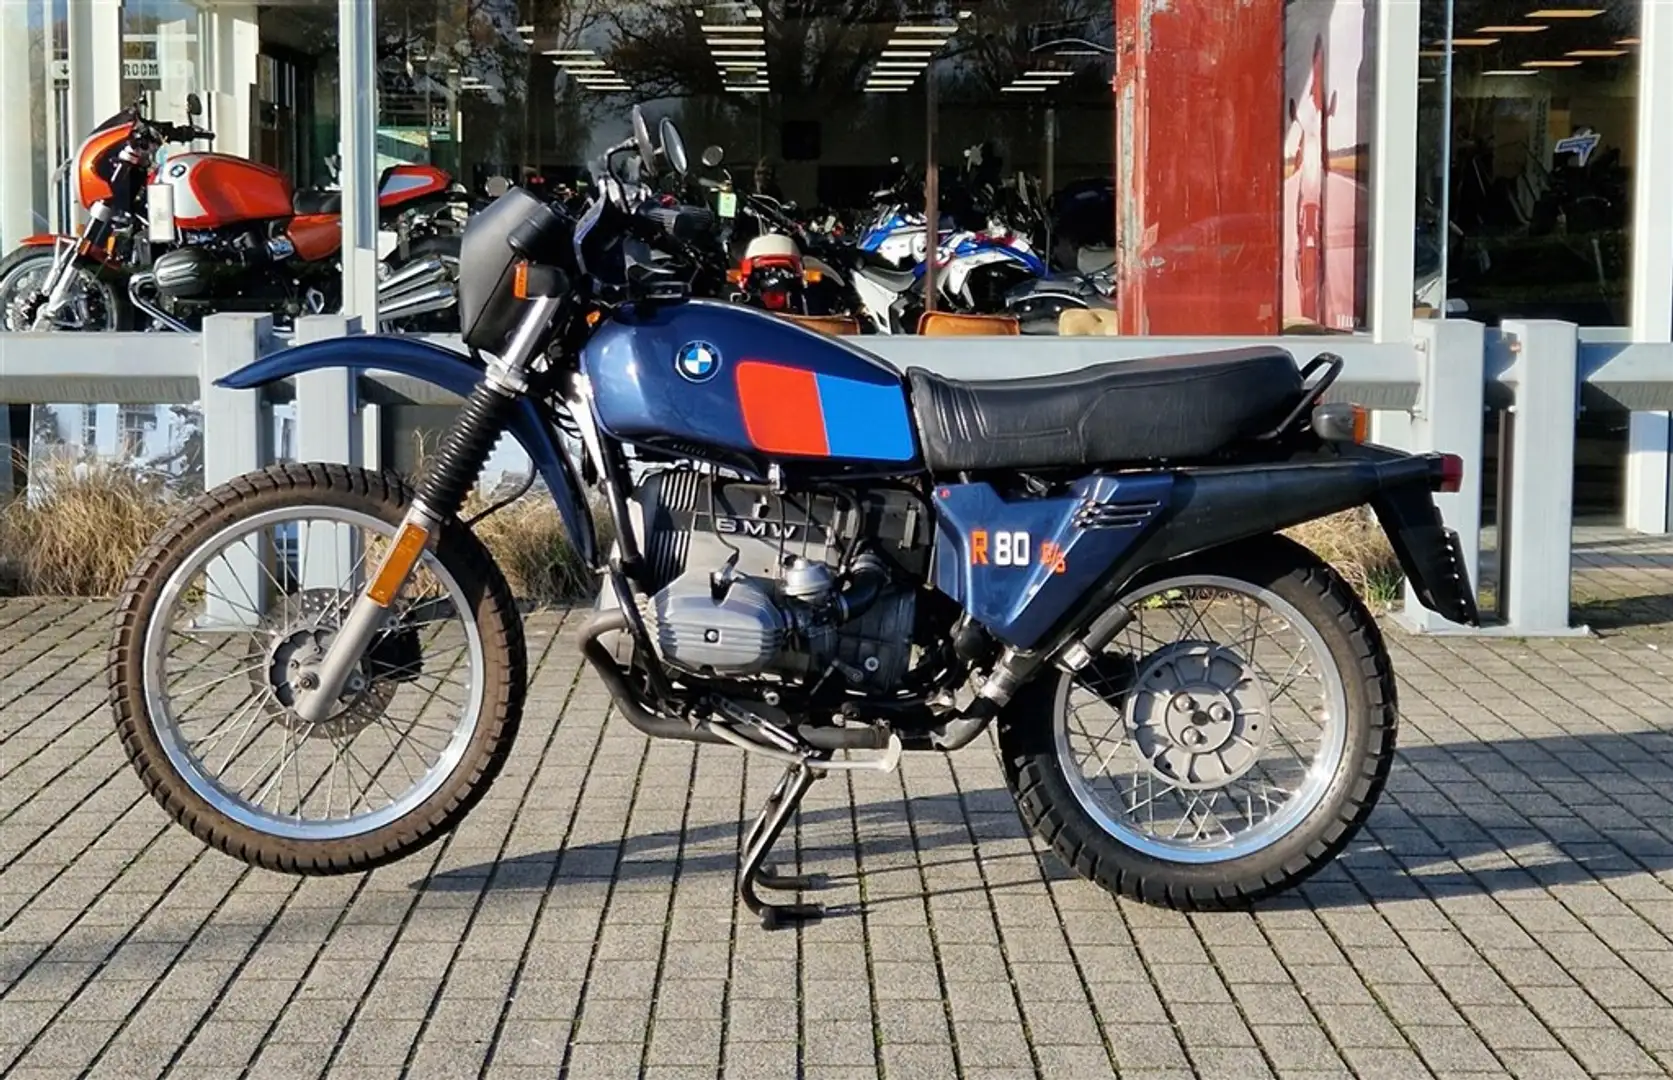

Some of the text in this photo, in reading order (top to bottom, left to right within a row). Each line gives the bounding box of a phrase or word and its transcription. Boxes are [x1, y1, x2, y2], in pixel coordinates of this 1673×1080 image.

[716, 518, 796, 538] BMW
[970, 529, 989, 565] R
[994, 531, 1030, 565] 80
